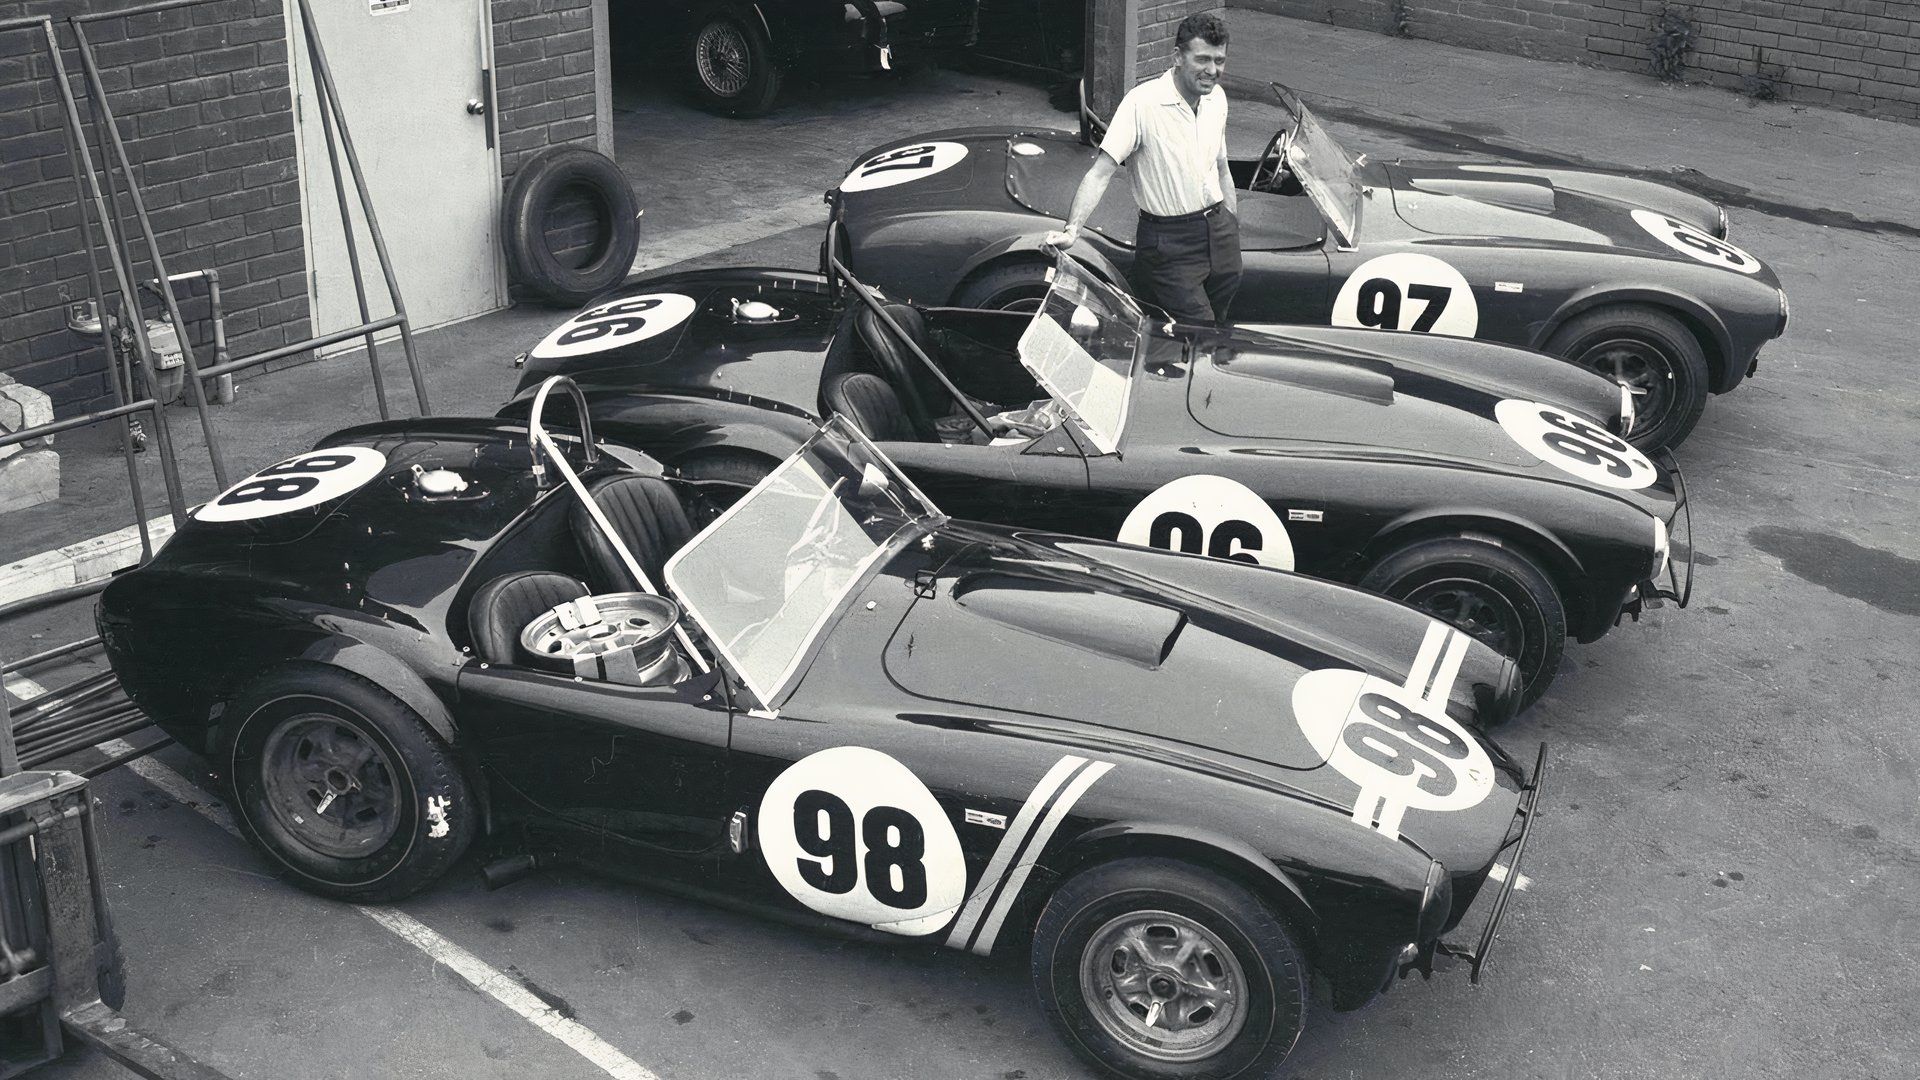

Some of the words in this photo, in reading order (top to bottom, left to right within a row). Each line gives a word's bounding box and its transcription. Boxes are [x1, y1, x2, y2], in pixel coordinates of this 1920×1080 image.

[861, 146, 936, 178] 97
[557, 299, 663, 346] 96
[1357, 277, 1452, 333] 97
[1539, 410, 1633, 479] 96
[217, 455, 356, 506] 98
[1342, 692, 1470, 797] 98
[793, 789, 928, 910] 98
